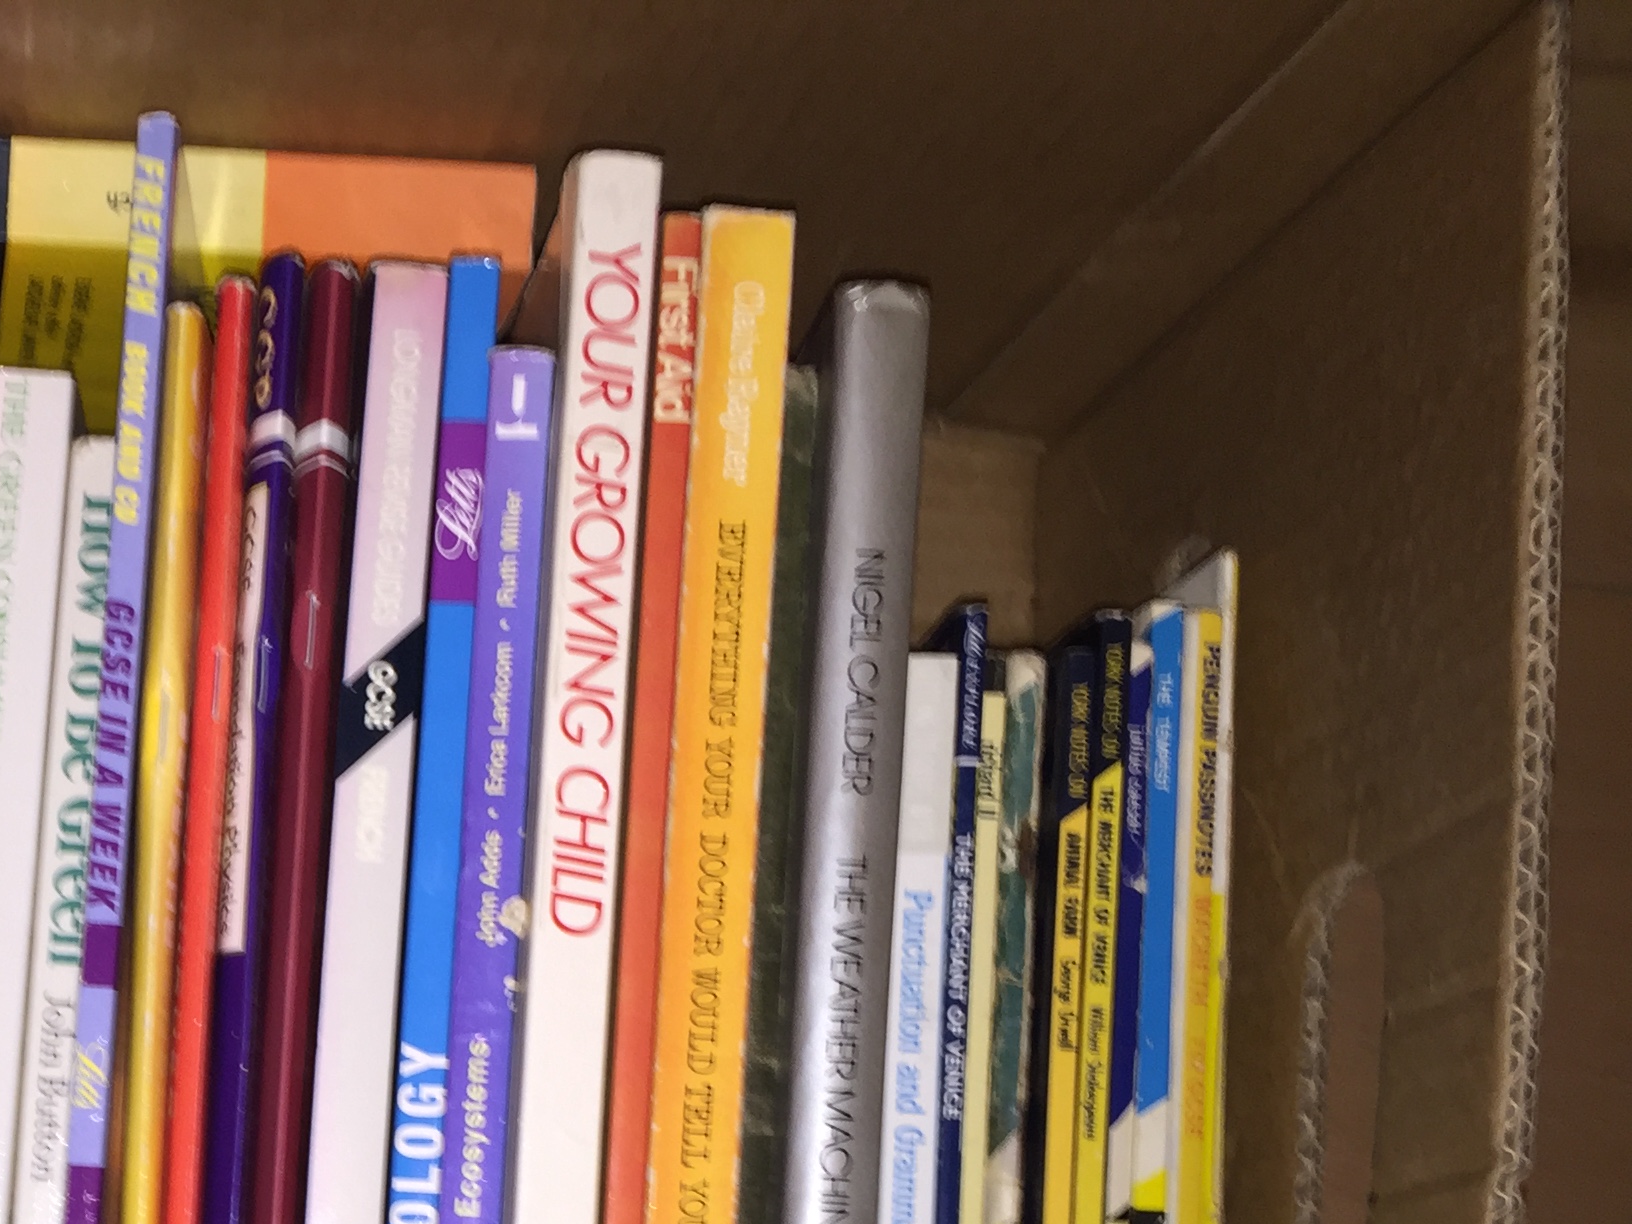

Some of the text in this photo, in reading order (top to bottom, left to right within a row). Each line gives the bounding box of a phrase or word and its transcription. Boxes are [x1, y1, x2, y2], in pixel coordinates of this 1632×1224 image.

[125, 153, 166, 318] FRENCH
[120, 340, 148, 416] BOOK
[653, 254, 700, 423] First Aid
[719, 280, 767, 487] Claire Rayner
[117, 421, 144, 481] AND
[434, 467, 484, 561] Letts
[499, 488, 523, 552] Miller
[495, 555, 519, 608] Ruth
[550, 243, 643, 937] YOUR GROWING CHILD
[709, 519, 748, 730] EVERYTHING
[850, 547, 887, 648] NIGEL
[365, 659, 399, 731] GCSE
[840, 654, 879, 797] CALDER
[1156, 673, 1174, 709] THE
[88, 600, 137, 914] GCSE IN A WEEK
[483, 739, 509, 797] Erica
[701, 736, 735, 820] YOUR
[1068, 683, 1090, 799] YORK NOTES ON
[1195, 641, 1222, 877] PENGUIN PASSNOTES
[1099, 788, 1115, 814] THE
[692, 831, 730, 957] DOCTOR
[834, 855, 869, 915] THE
[1062, 831, 1084, 889] ANIMAL
[1094, 820, 1115, 900] MERCHANT
[474, 890, 508, 947] John
[1060, 893, 1081, 939] FARM
[1091, 932, 1110, 986] VENICE
[1092, 907, 1111, 926] OF
[824, 919, 866, 1082] WEATHER
[896, 889, 935, 1054] Punctuation
[942, 834, 974, 1121] THE MERCHANT OF VENICE
[685, 967, 722, 1076] WOULD
[1086, 1005, 1106, 1056] William
[29, 990, 74, 1185] John Button
[453, 1038, 491, 1217] Ecosystems
[679, 1082, 715, 1169] TELL
[895, 1061, 924, 1115] and
